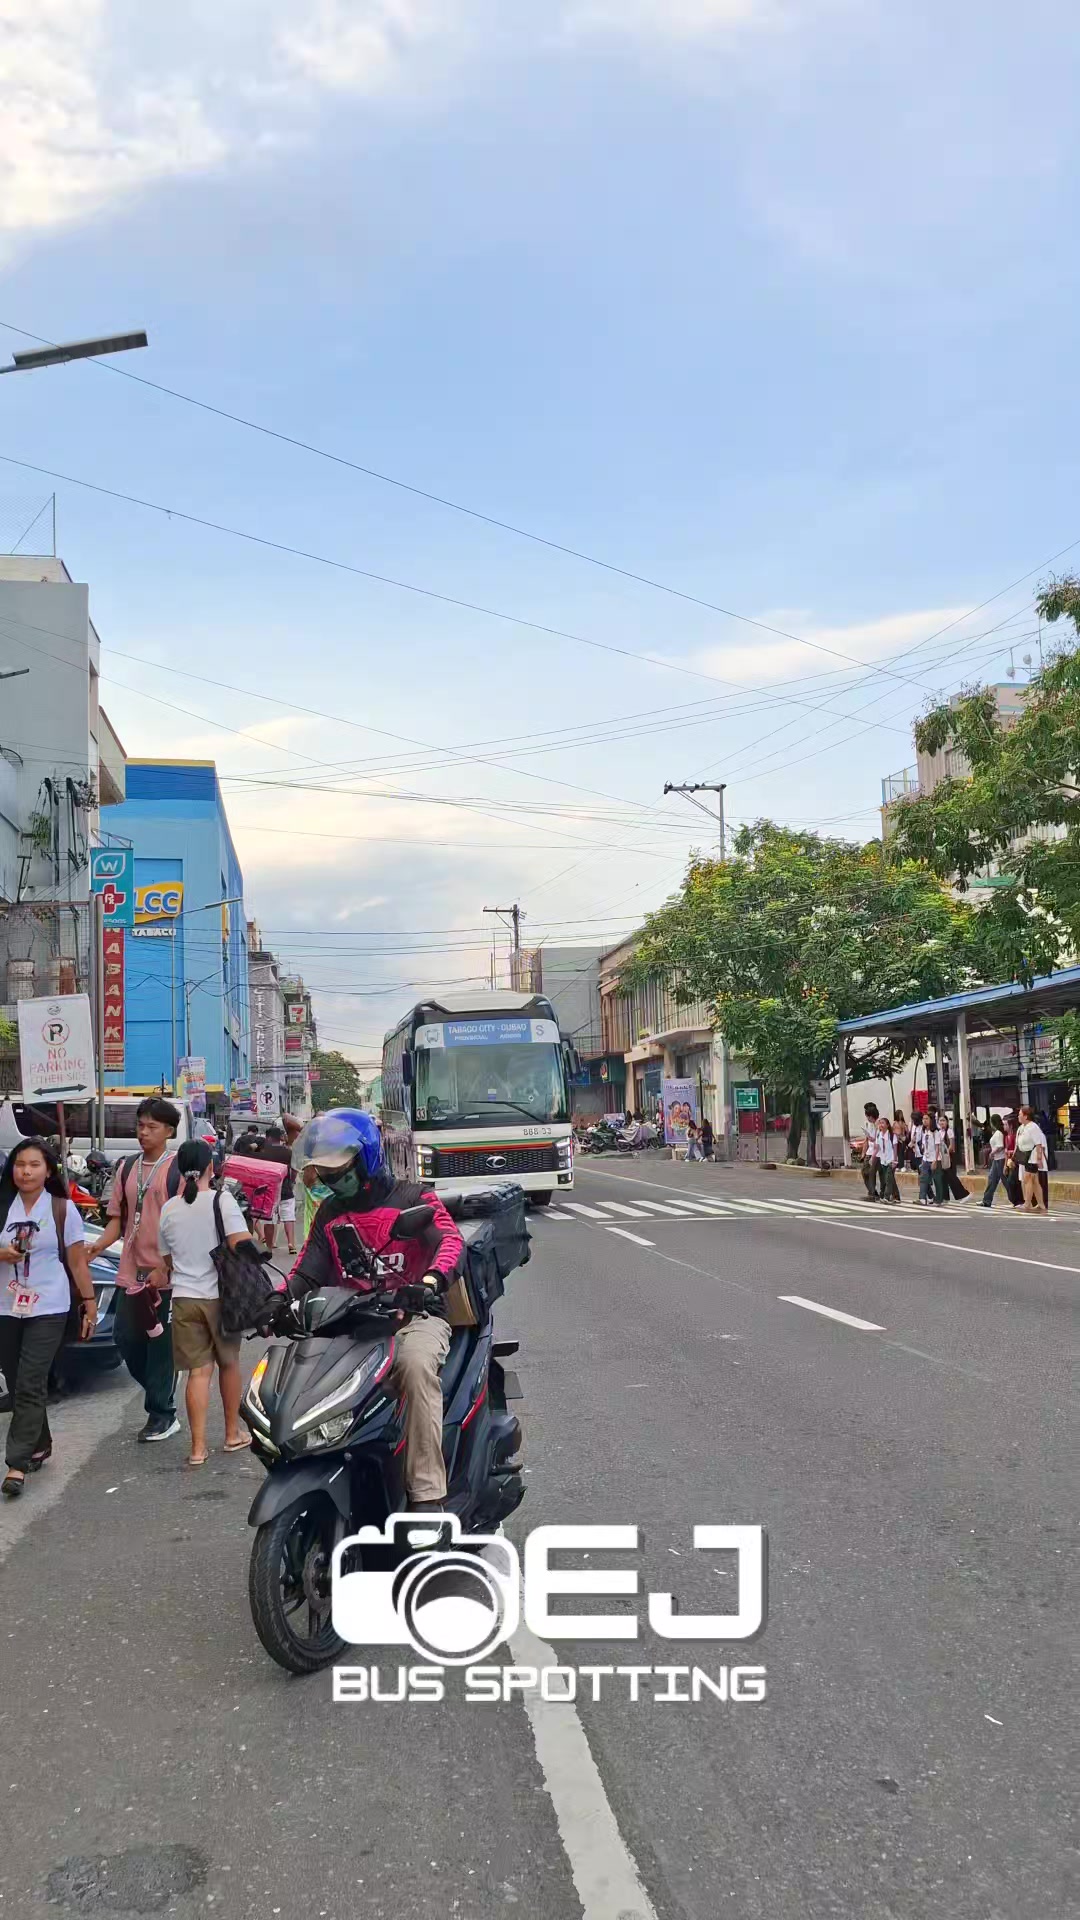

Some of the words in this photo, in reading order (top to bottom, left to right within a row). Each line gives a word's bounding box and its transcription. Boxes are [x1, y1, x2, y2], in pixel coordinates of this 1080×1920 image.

[134, 889, 180, 914] LCC
[48, 1047, 66, 1060] NO
[30, 1059, 87, 1074] PARKING
